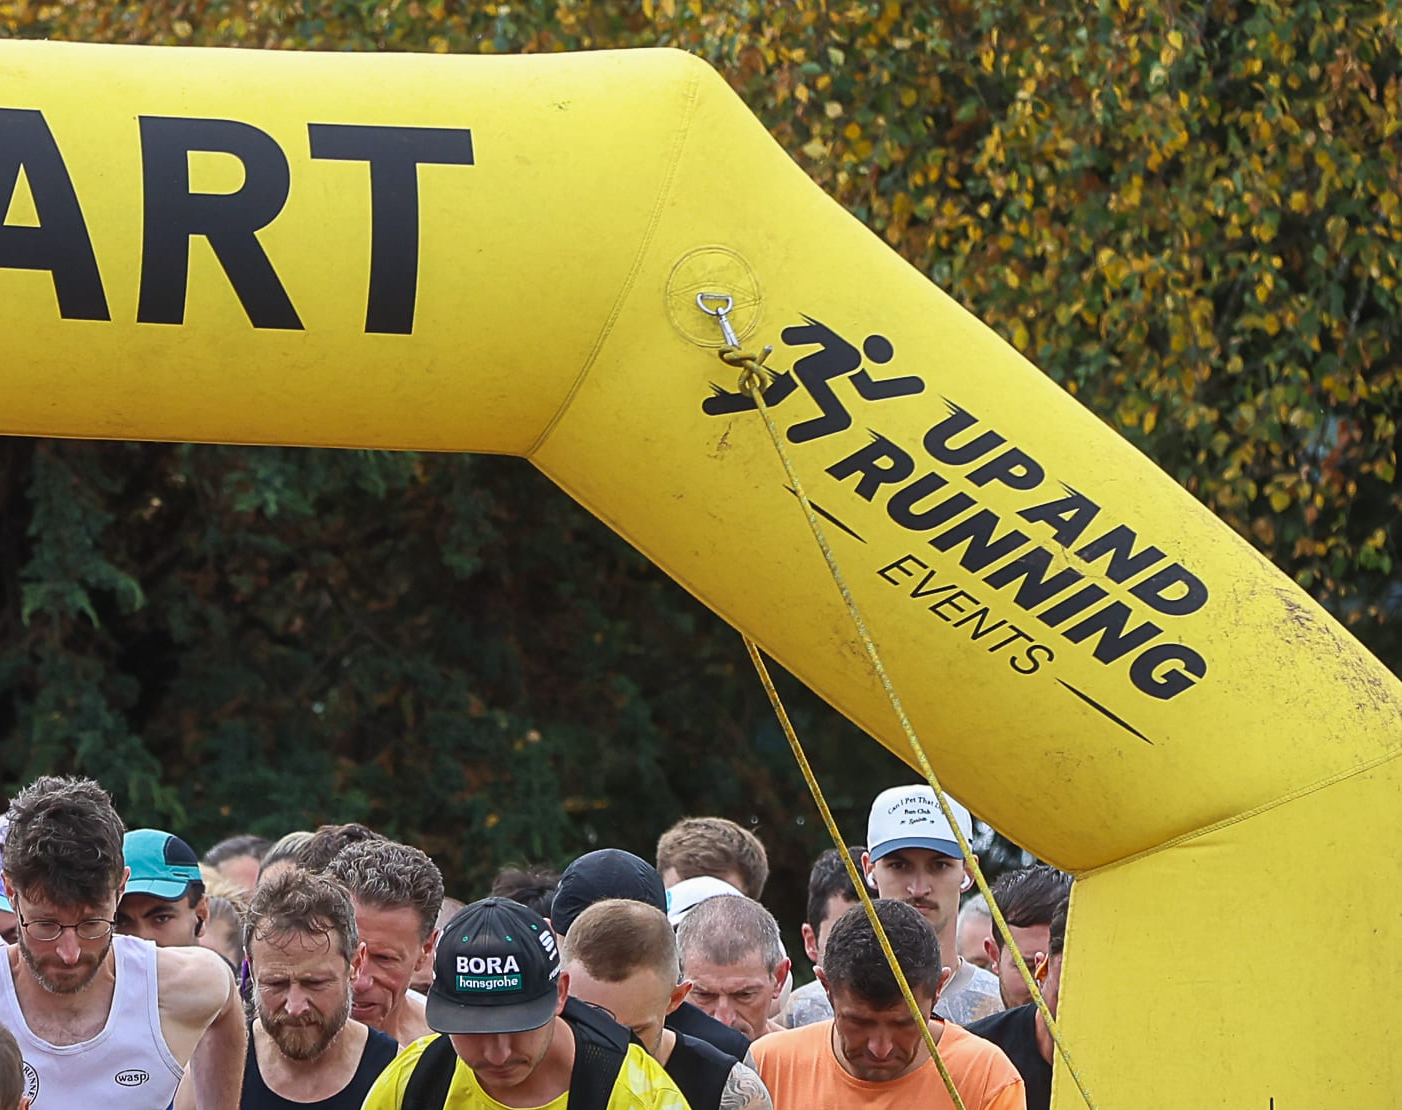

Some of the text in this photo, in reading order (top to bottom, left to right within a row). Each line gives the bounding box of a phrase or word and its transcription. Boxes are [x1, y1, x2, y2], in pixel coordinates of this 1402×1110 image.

[923, 396, 1209, 617] UP AND
[825, 428, 1208, 701] RUNNING
[877, 553, 1056, 676] EVENTS
[456, 955, 520, 975] BORA
[459, 975, 519, 990] hansgrohe
[23, 1065, 37, 1098] RUNNE
[117, 1072, 147, 1086] wasp
